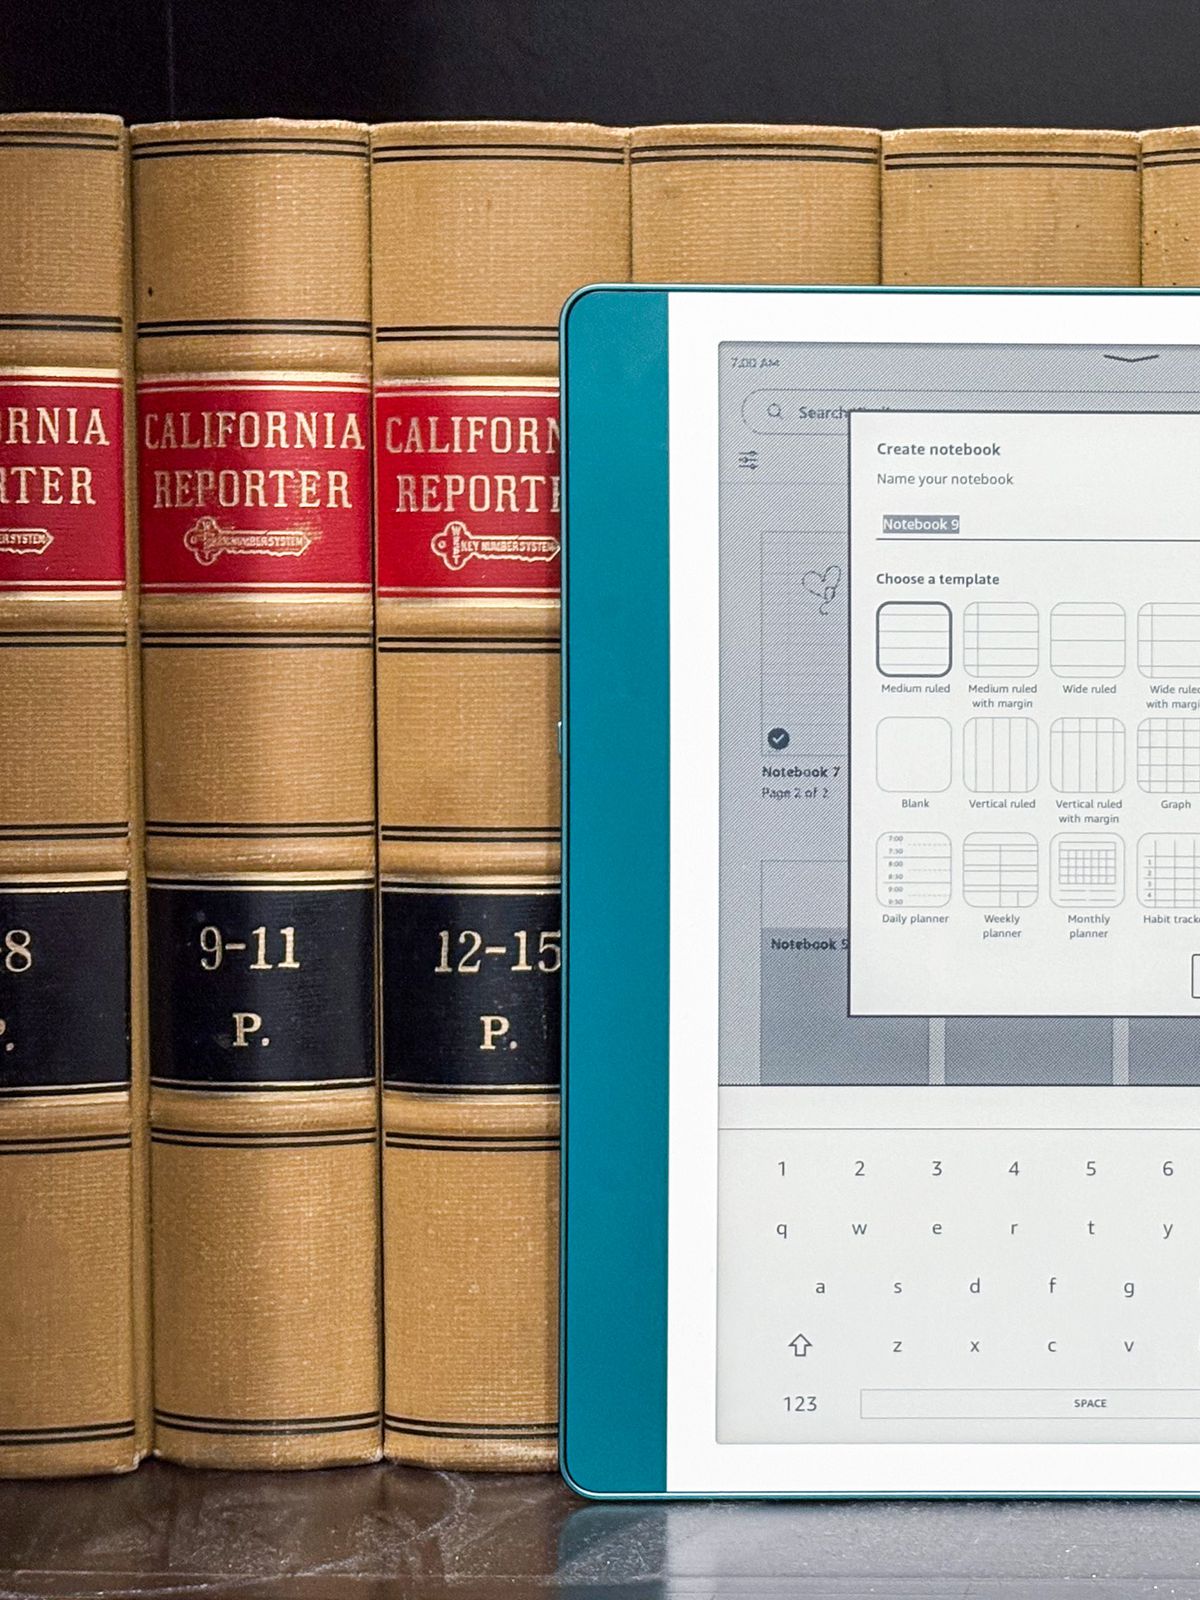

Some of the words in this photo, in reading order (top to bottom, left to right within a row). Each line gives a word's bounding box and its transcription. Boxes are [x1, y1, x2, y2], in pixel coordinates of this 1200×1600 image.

[0, 406, 110, 446] RNIA
[145, 409, 365, 451] CALIFORNIA
[876, 442, 926, 456] Create
[929, 442, 1001, 456] notebook
[876, 472, 916, 485] Name
[918, 475, 948, 488] your
[951, 472, 1014, 486] notebook
[153, 469, 352, 509] REPORTER
[884, 518, 948, 531] Notebook
[951, 518, 960, 531] 9
[876, 572, 925, 585] Choose
[927, 575, 936, 585] a
[939, 573, 1000, 588] template
[881, 682, 922, 694] Medium
[924, 683, 951, 694] ruled
[968, 683, 1009, 694] Medium
[1011, 683, 1038, 694] ruled
[1062, 683, 1089, 694] Wide
[1090, 684, 1117, 694] ruled
[1149, 684, 1176, 695] Wide
[971, 698, 994, 708] with
[999, 698, 1034, 711] margin
[1145, 698, 1169, 709] with
[762, 766, 828, 777] Notebook
[833, 766, 841, 777] 7
[901, 798, 930, 809] Blank
[968, 798, 1008, 809] Vertical
[1010, 798, 1036, 809] ruled
[1055, 799, 1095, 809] Vertical
[1096, 799, 1123, 809] ruled
[1160, 799, 1192, 812] Graph
[1058, 813, 1081, 824] with
[1083, 814, 1120, 826] margin
[881, 913, 908, 926] Daily
[910, 913, 950, 926] planner
[983, 913, 1021, 926] Weekly
[1067, 913, 1111, 926] Monthly
[1143, 914, 1171, 924] Habit
[982, 928, 1023, 940] planner
[1069, 928, 1109, 941] planner
[200, 926, 300, 970] 9-11
[771, 938, 835, 950] Notebook
[0, 930, 31, 972] 8
[434, 929, 561, 973] 12-15
[232, 1012, 270, 1047] P.
[479, 1015, 518, 1050] P.
[778, 1161, 785, 1177] 1
[854, 1160, 865, 1177] 2
[931, 1160, 943, 1177] 3
[1008, 1160, 1020, 1177] 4
[1086, 1160, 1097, 1177] 5
[1162, 1160, 1174, 1177] 6
[776, 1223, 788, 1240] q
[851, 1223, 868, 1236] w
[932, 1223, 943, 1235] e
[1010, 1223, 1019, 1235] r
[1087, 1220, 1095, 1235] t
[1162, 1223, 1174, 1240] y
[815, 1282, 826, 1294] a
[893, 1282, 903, 1294] s
[969, 1277, 981, 1294] d
[1049, 1276, 1057, 1294] f
[1123, 1282, 1135, 1299] g
[892, 1340, 903, 1353] z
[970, 1340, 980, 1353] x
[1047, 1340, 1057, 1353] c
[1123, 1341, 1135, 1353] v
[783, 1395, 818, 1412] 123
[1074, 1398, 1107, 1409] SPACE
